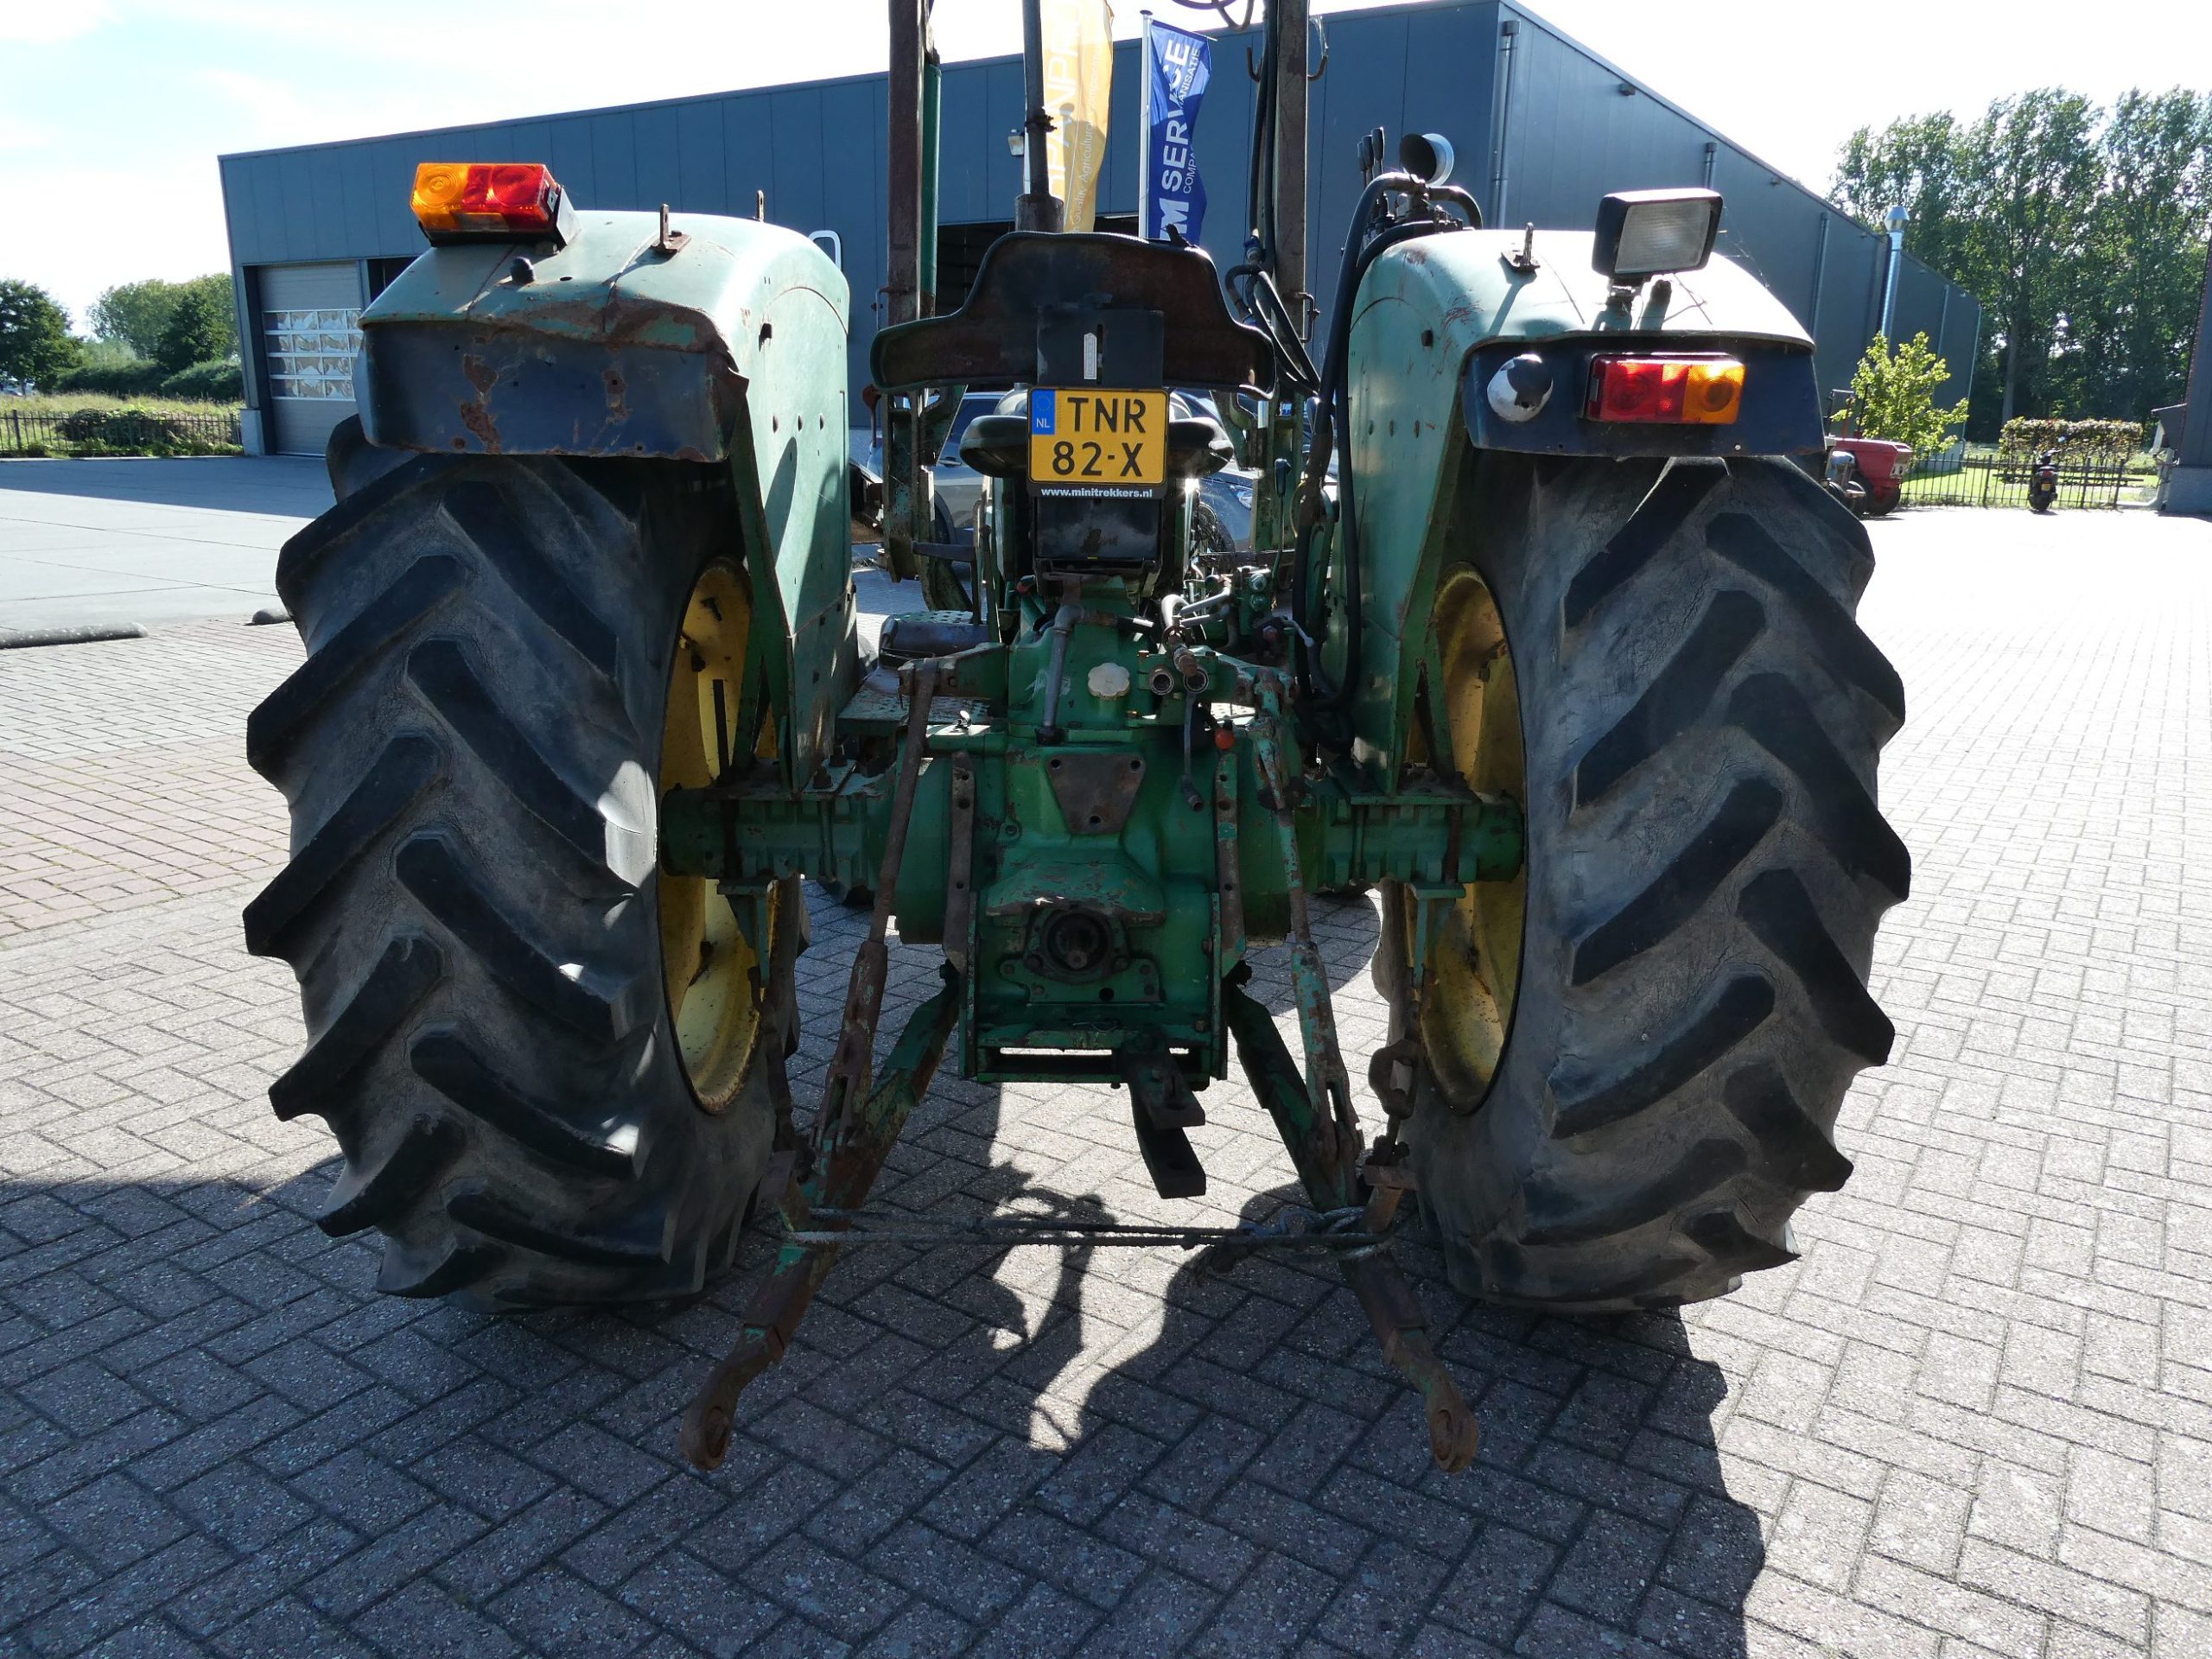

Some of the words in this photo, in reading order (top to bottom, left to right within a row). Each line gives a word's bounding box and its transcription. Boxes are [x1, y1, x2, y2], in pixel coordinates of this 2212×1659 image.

[1161, 39, 1190, 192] SERVCE
[1036, 417, 1051, 429] NL
[1067, 397, 1146, 434] TNR
[1052, 441, 1143, 477] 82-X
[1040, 487, 1153, 499] www.minitrekkers.nl
